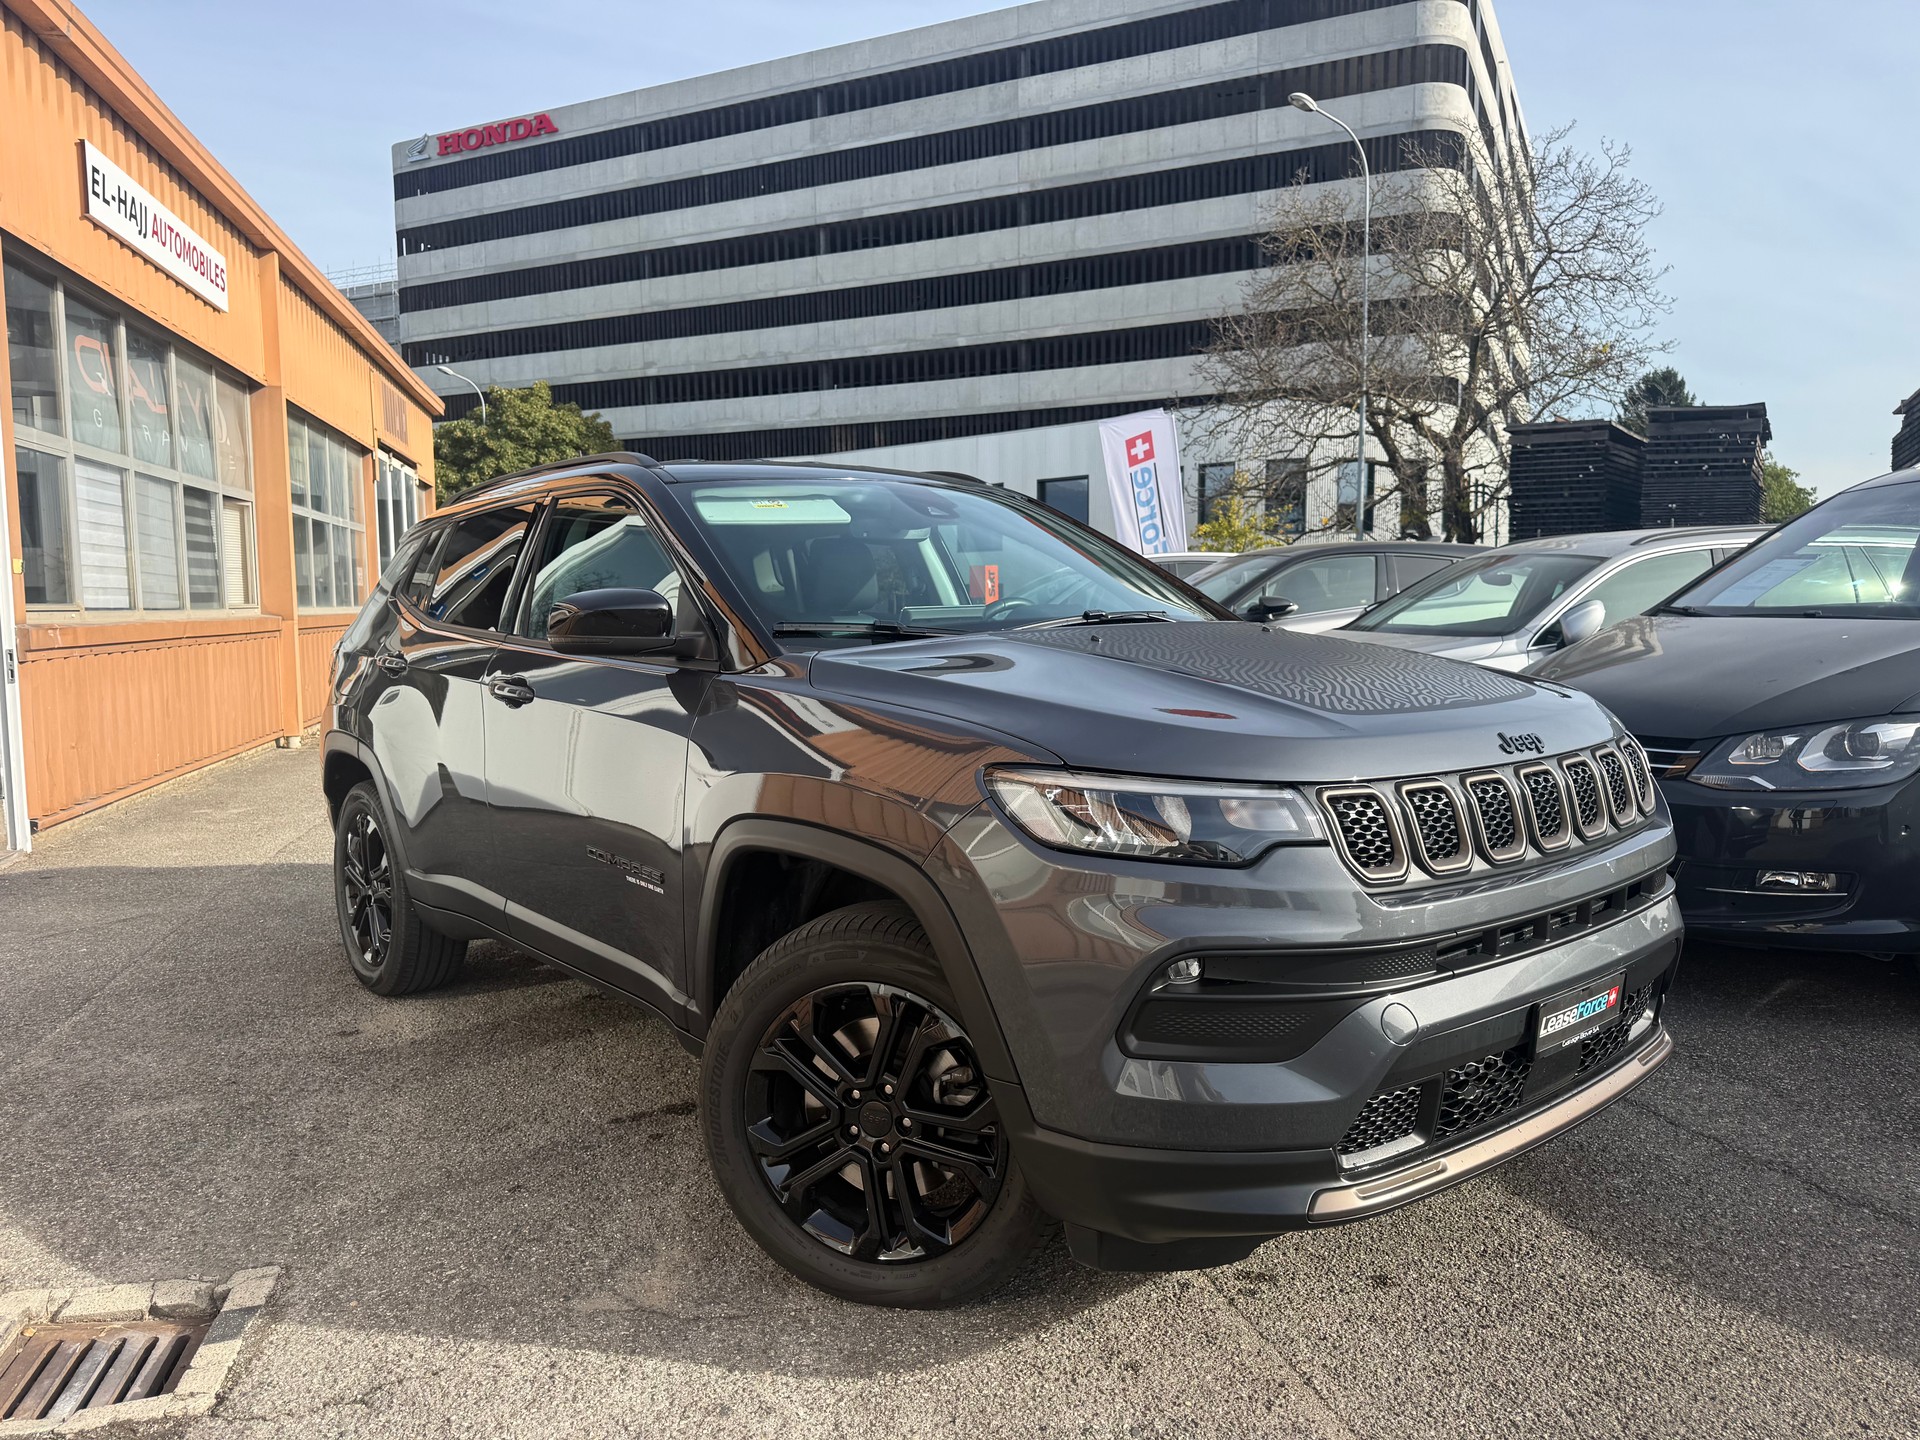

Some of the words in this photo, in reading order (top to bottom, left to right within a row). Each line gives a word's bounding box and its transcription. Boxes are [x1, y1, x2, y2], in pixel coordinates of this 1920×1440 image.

[437, 113, 559, 156] HONDA
[91, 165, 148, 239] EL-HAJJ
[151, 213, 226, 293] AUTOMOBILES
[1497, 731, 1546, 755] Jeep
[586, 845, 664, 885] COMPASS
[747, 963, 802, 1003] TURANZA
[1539, 993, 1609, 1037] LeaseForce
[708, 1040, 731, 1167] BRIDGESTONE
